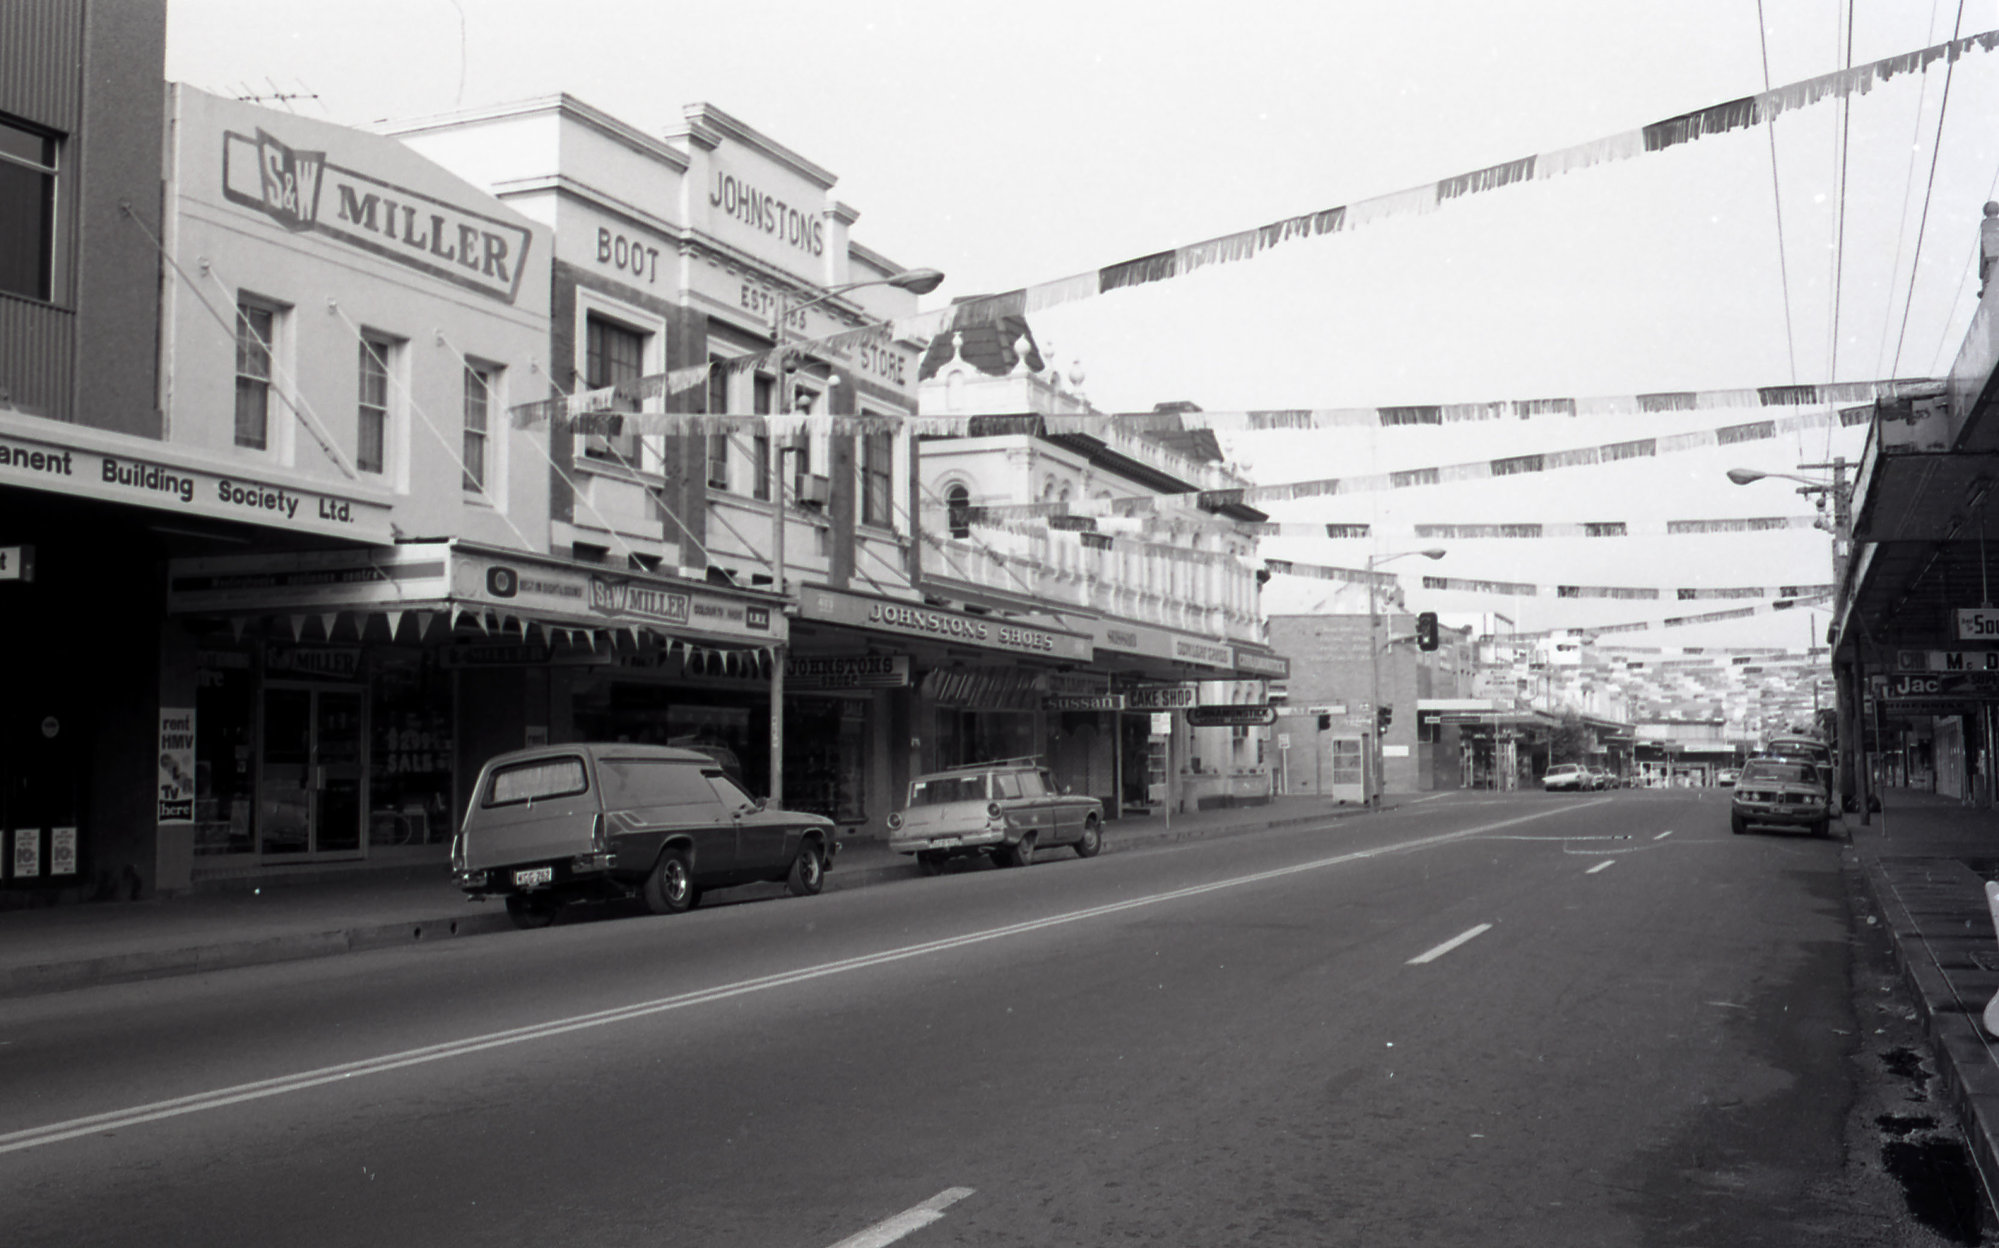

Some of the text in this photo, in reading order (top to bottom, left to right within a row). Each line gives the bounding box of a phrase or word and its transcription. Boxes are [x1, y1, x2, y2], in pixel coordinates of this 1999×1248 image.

[265, 146, 512, 284] S&W MILLER
[709, 170, 824, 257] JOHNSTONS
[597, 227, 660, 285] BOOT
[860, 342, 906, 386] STORE
[102, 460, 195, 502] Building
[218, 479, 299, 518] Society
[318, 495, 355, 524] Ltd.
[595, 579, 687, 619] S&W MILLER
[869, 604, 1055, 651] JOHNSTONS SHOES
[787, 657, 893, 676] JOHNSTONS
[1047, 697, 1114, 710] sussan
[1130, 689, 1192, 707] CAKE SHOP
[161, 734, 194, 750] HMV
[163, 715, 190, 731] rent
[160, 802, 192, 818] here
